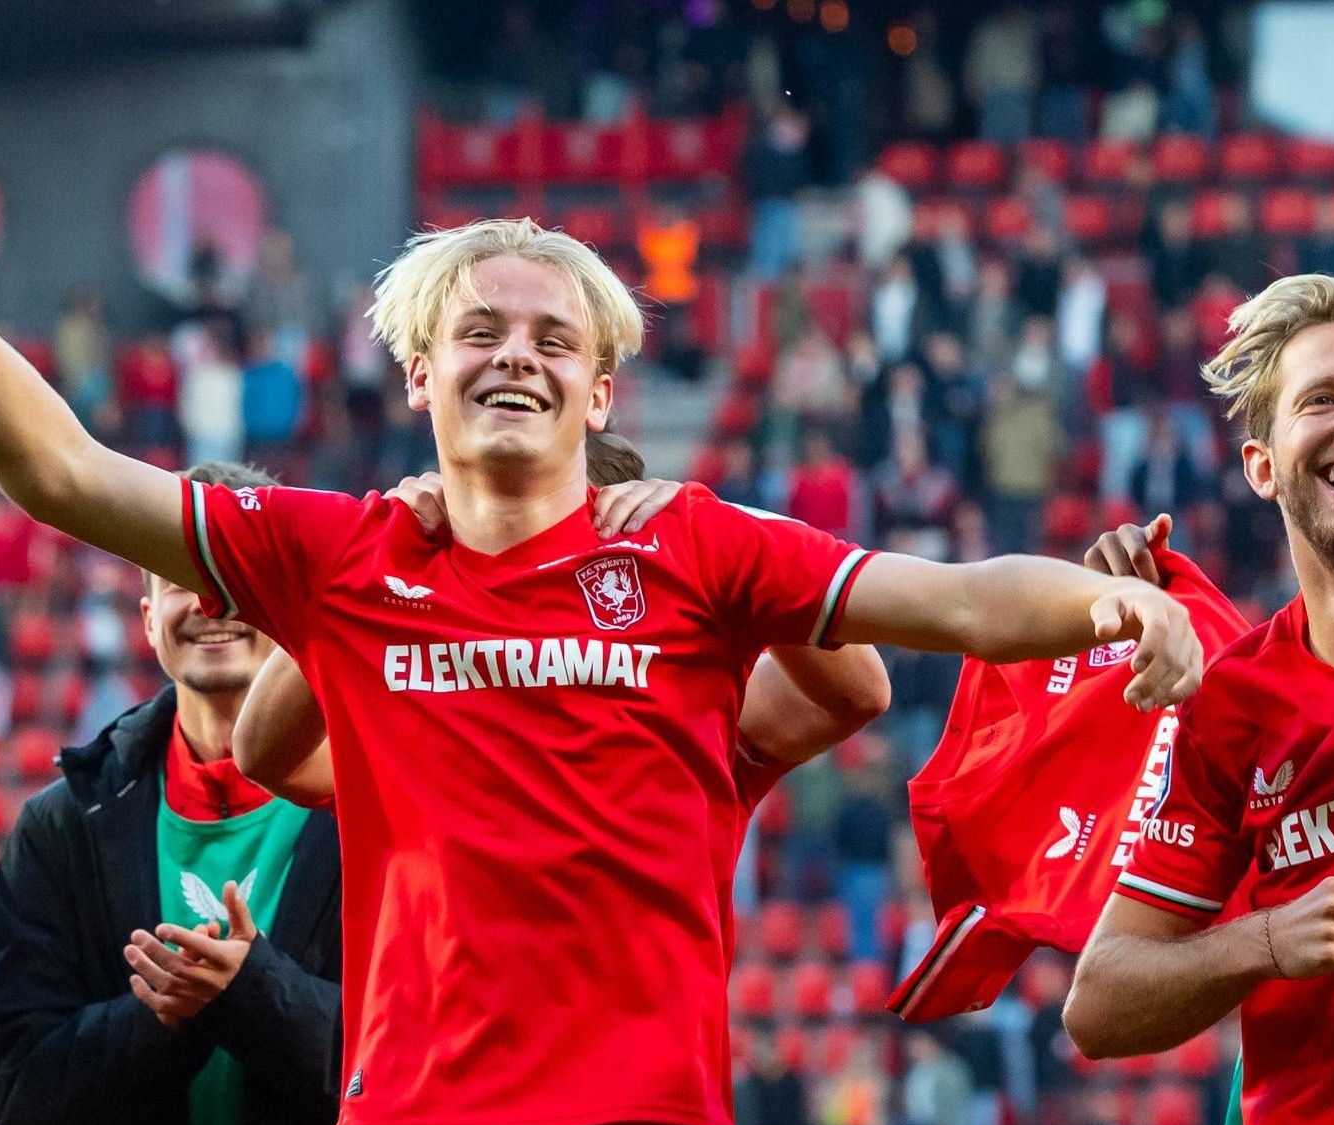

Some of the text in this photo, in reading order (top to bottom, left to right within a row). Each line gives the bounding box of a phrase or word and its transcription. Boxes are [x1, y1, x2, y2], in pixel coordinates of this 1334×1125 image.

[594, 558, 632, 572] TWENTE
[384, 638, 661, 692] ELEKTRAMAT
[1046, 655, 1078, 694] ELE
[1074, 813, 1097, 861] CASTORE
